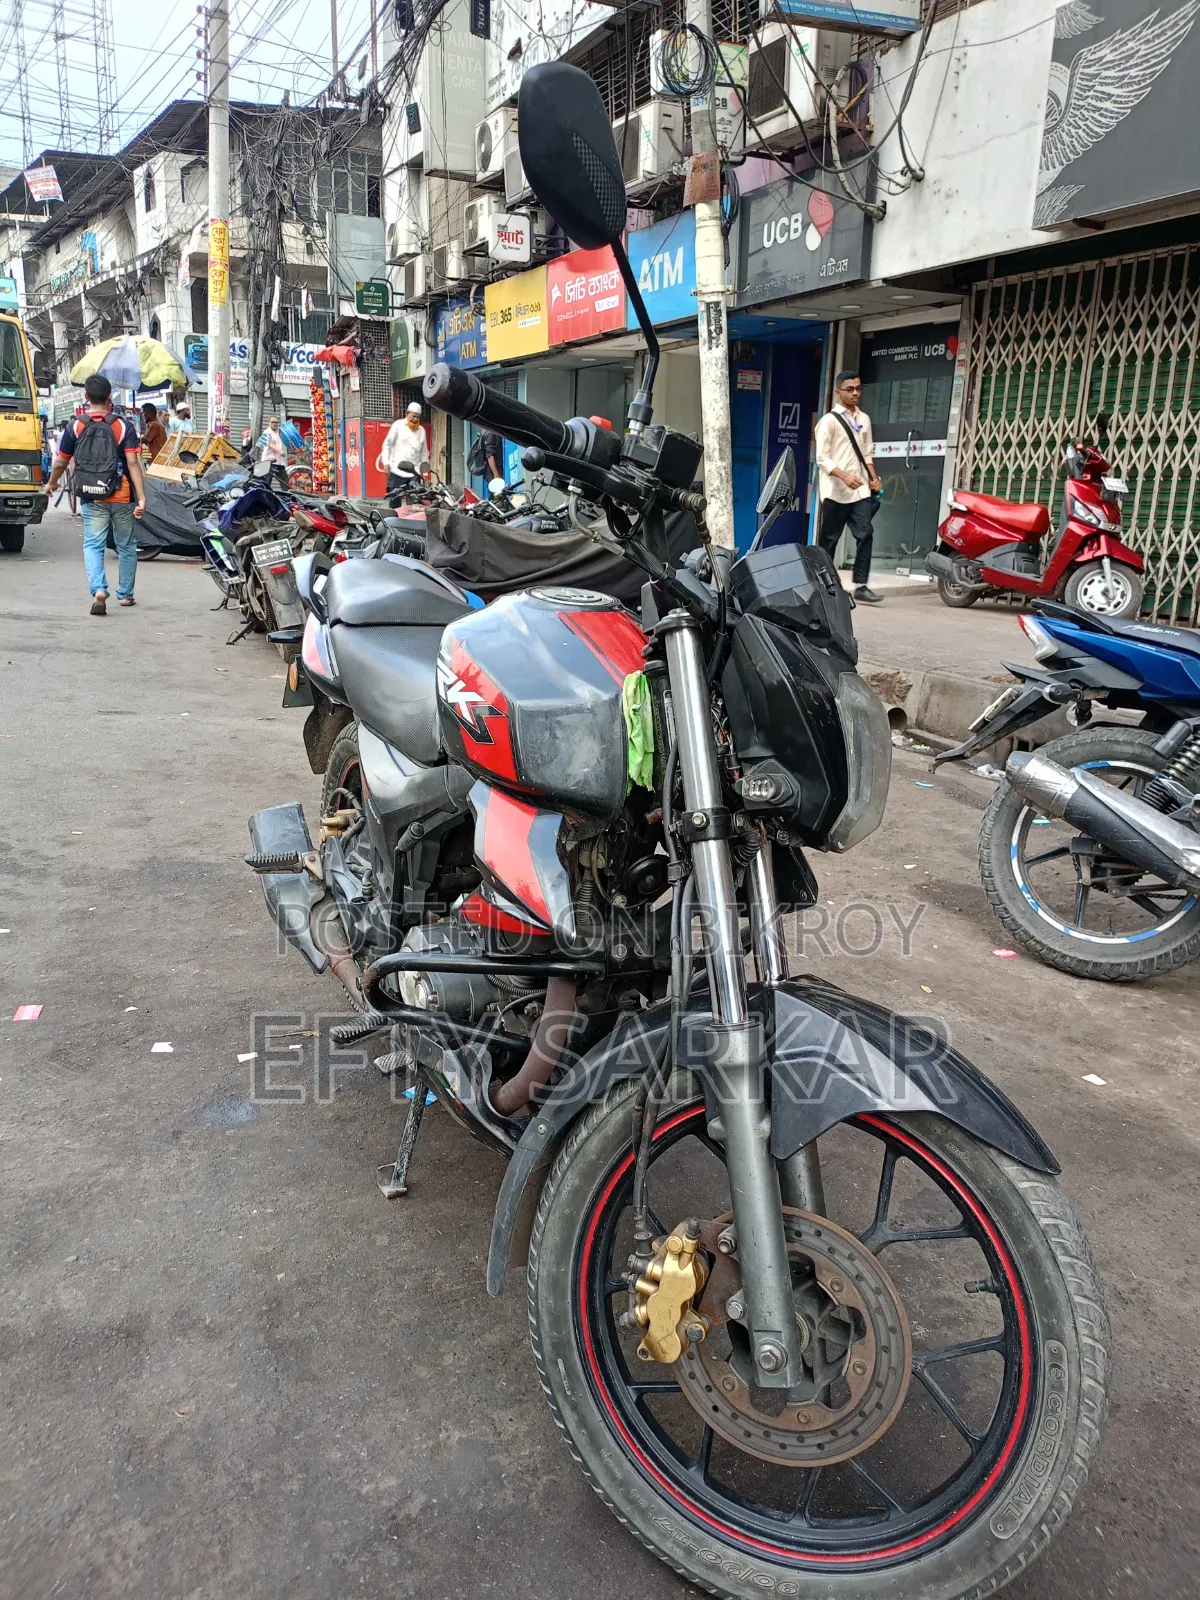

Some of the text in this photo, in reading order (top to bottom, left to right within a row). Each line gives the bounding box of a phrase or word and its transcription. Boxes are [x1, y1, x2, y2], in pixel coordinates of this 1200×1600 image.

[452, 76, 477, 89] CARE
[763, 212, 802, 248] UCB
[639, 246, 683, 294] ATM
[820, 257, 850, 278] এটিএম
[565, 275, 586, 304] সিটি
[587, 268, 620, 296] ব্যাংক
[500, 307, 512, 324] 365
[461, 339, 477, 359] ATM
[888, 345, 918, 354] COMMERCIAL
[924, 344, 945, 357] UCB
[1002, 1391, 1063, 1519] CORDIAL
[653, 1516, 798, 1595] 90/90-17
